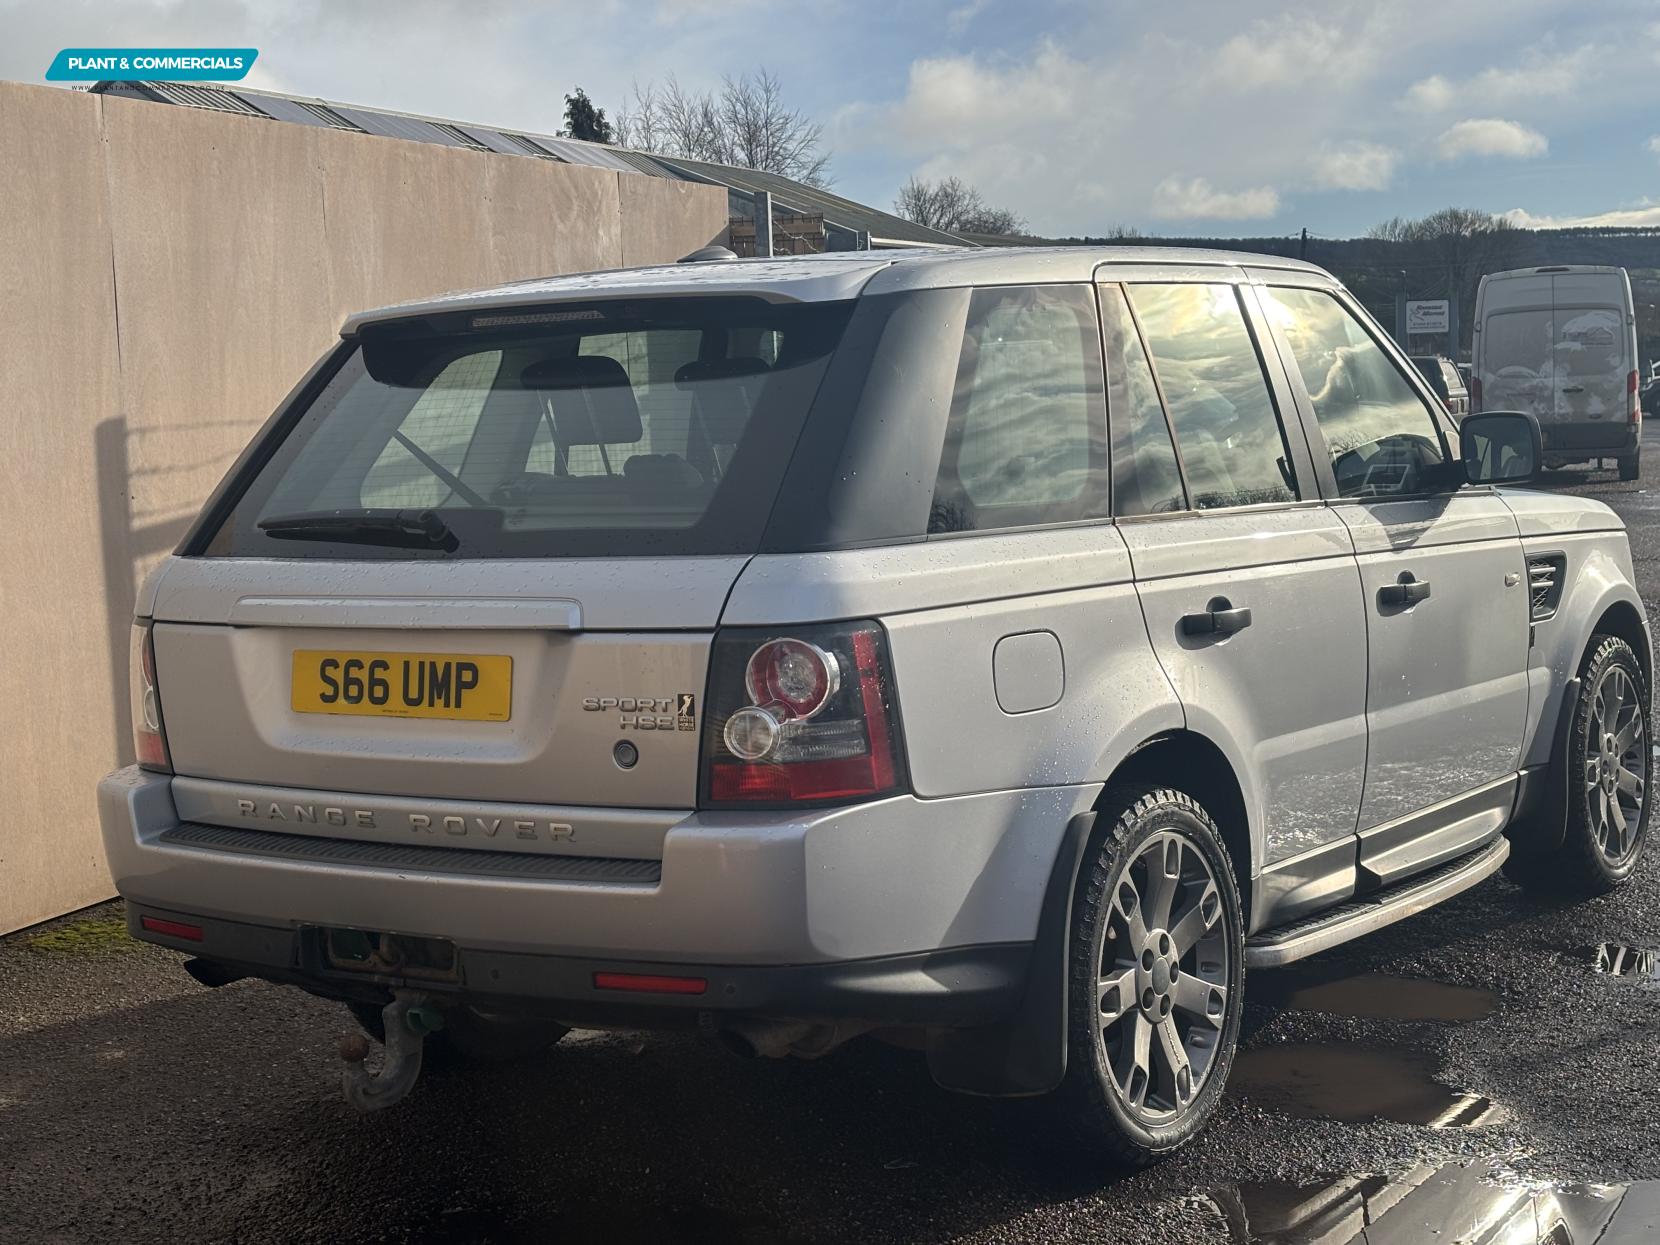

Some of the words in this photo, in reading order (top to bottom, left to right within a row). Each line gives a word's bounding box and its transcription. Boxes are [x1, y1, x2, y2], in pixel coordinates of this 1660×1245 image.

[319, 658, 390, 706] S66
[402, 660, 479, 709] UMP
[582, 697, 674, 712] SPORT
[620, 715, 675, 730] HSE
[238, 799, 377, 828] RANGE
[409, 814, 577, 842] ROVER
